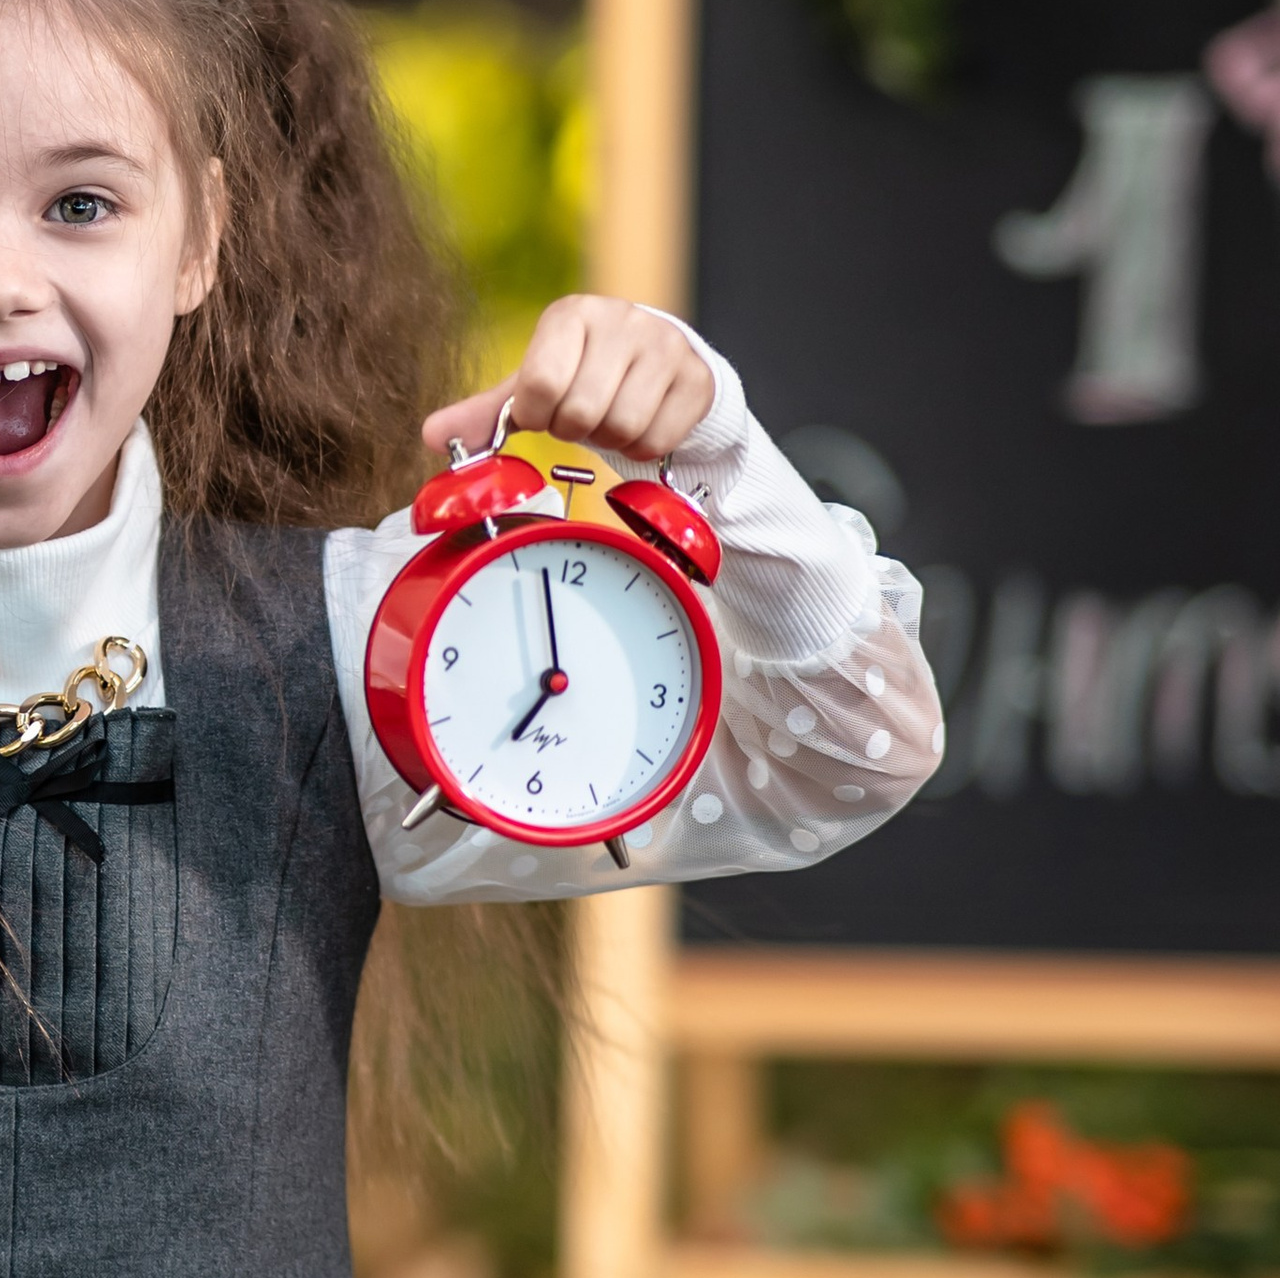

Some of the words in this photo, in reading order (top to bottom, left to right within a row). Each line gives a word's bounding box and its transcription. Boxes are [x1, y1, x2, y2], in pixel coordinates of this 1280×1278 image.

[990, 73, 1208, 422] 1
[561, 558, 587, 586] 12
[442, 646, 459, 671] 9
[649, 683, 668, 709] 3
[526, 770, 543, 795] 6
